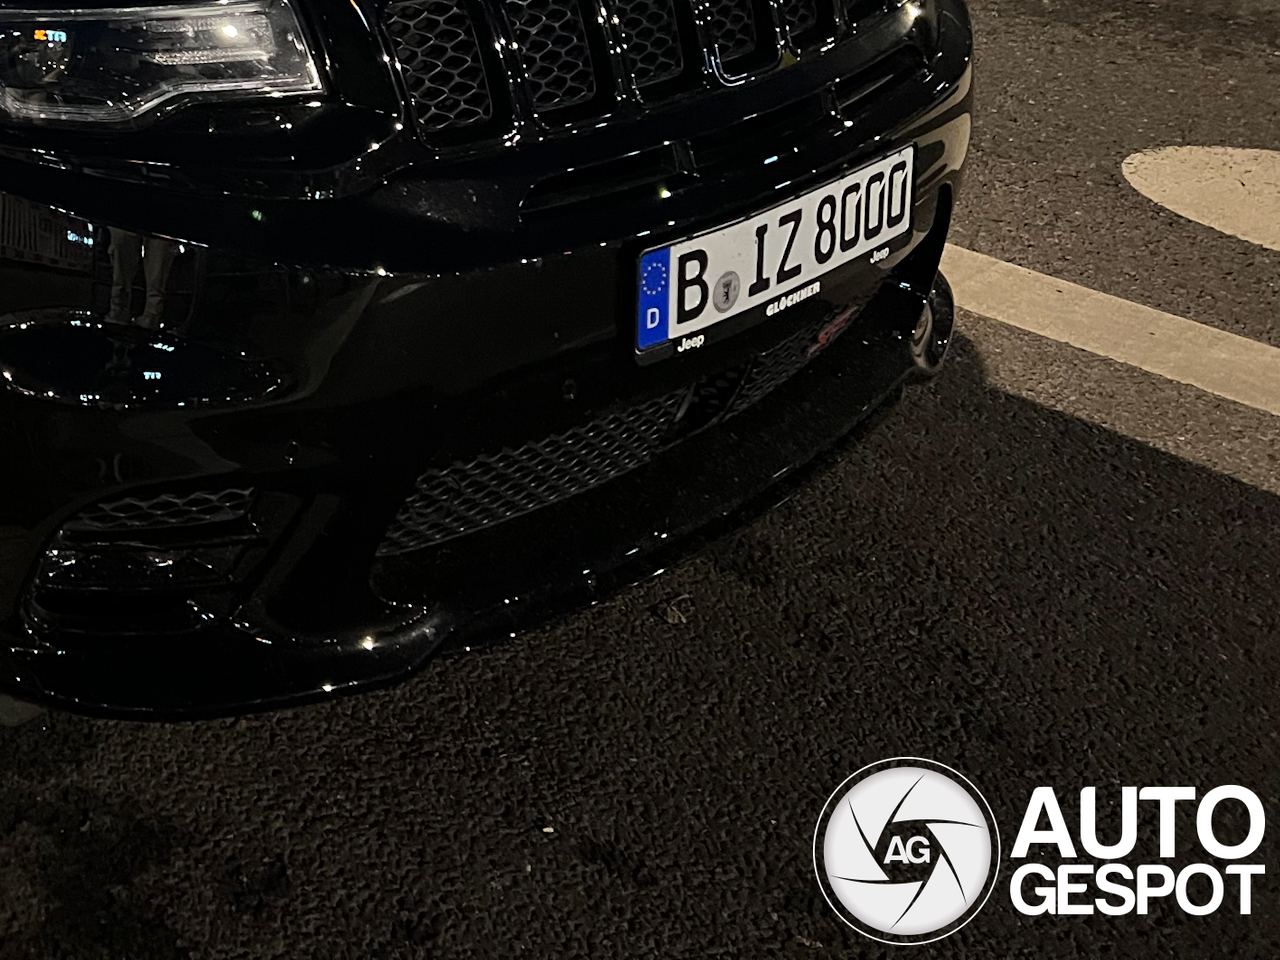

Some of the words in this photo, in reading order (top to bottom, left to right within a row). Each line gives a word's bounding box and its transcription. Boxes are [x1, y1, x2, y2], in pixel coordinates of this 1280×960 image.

[677, 249, 709, 325] B
[748, 208, 803, 298] IZ
[815, 160, 907, 265] 8000
[870, 247, 890, 264] Jeep
[646, 307, 660, 329] D
[677, 335, 705, 352] Jeep
